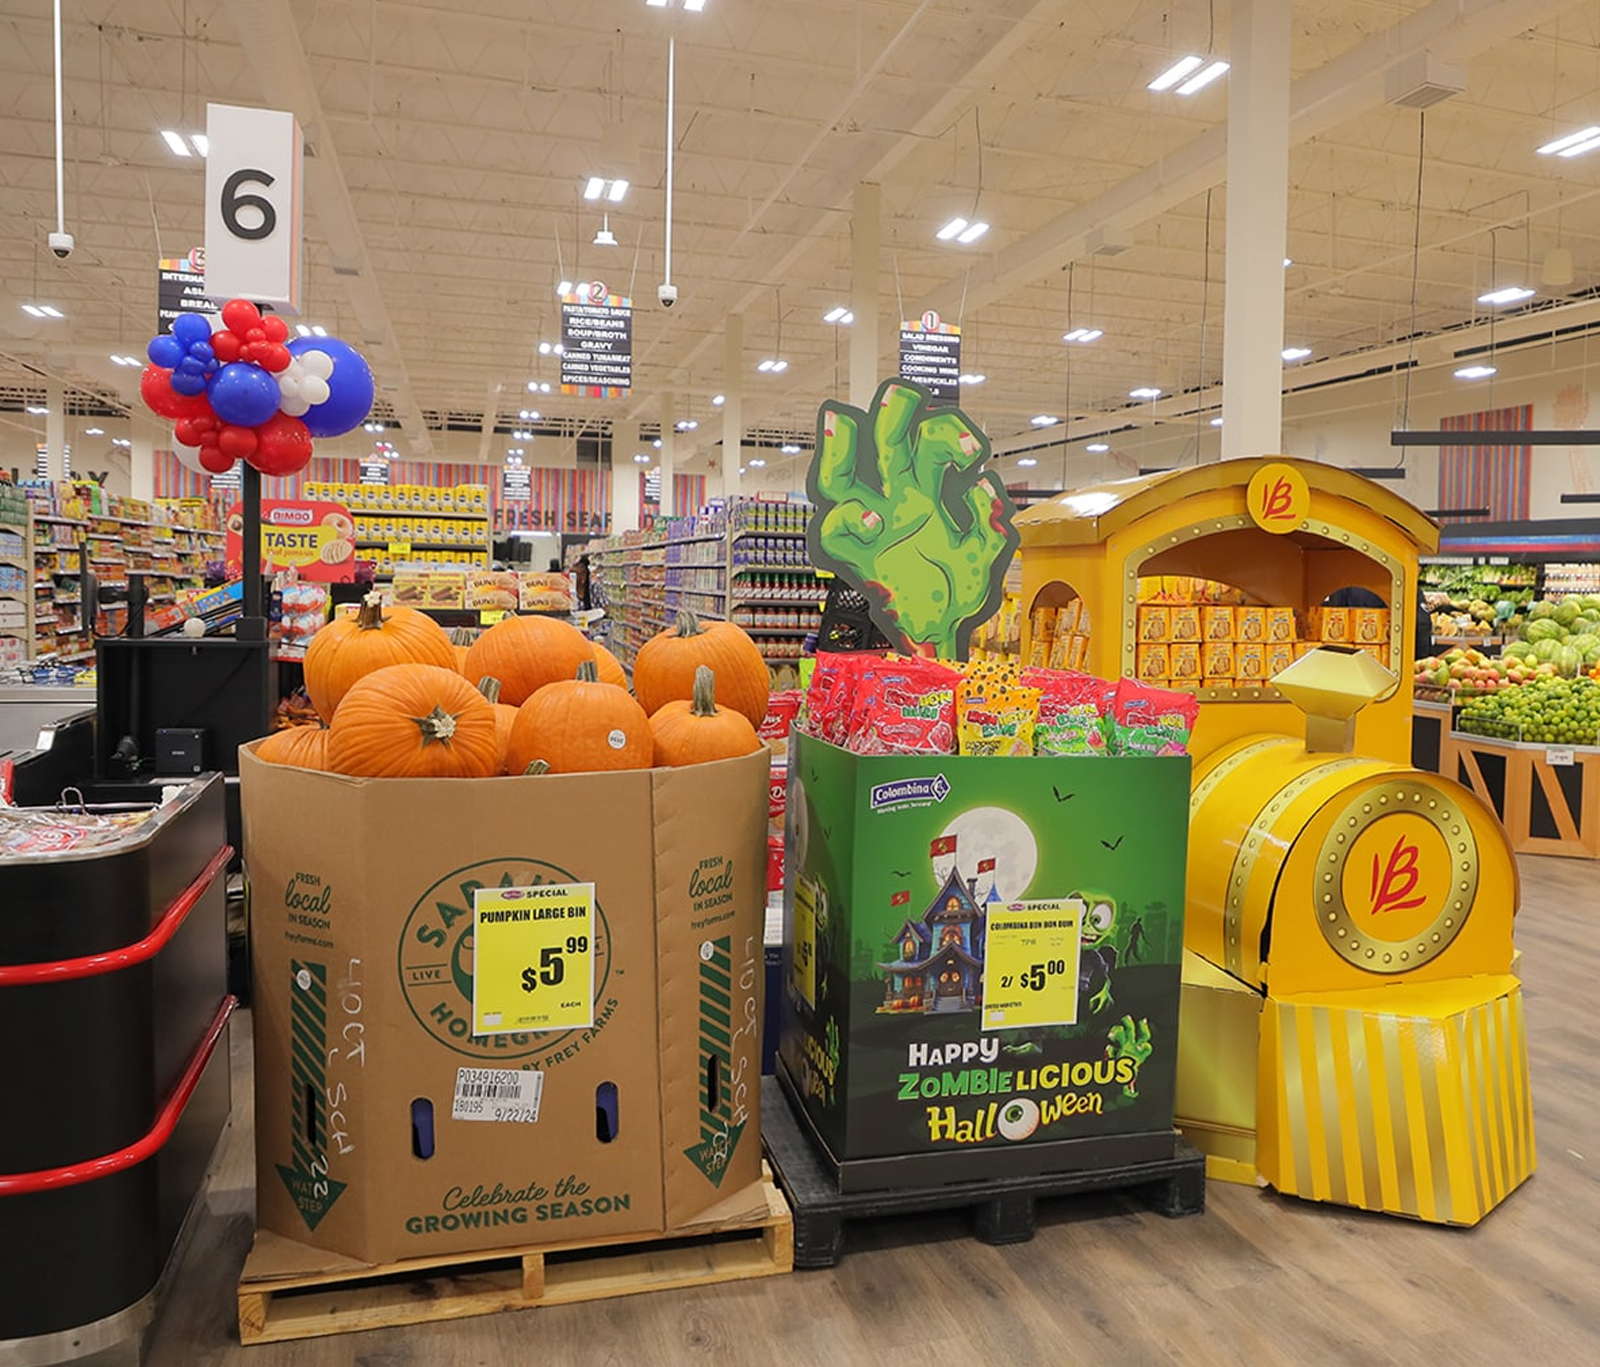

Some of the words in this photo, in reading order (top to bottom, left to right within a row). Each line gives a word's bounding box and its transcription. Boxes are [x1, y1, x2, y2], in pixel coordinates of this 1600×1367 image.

[221, 168, 276, 240] 6
[593, 283, 603, 300] 2
[569, 317, 625, 328] RICE/BEANS
[928, 312, 934, 328] 1
[567, 328, 627, 339] SOUP/BROTH
[580, 340, 613, 350] GRAVY
[493, 508, 555, 527] FRESH
[265, 532, 318, 549] TASTE
[919, 690, 953, 707] BON
[876, 782, 930, 801] Colombina
[699, 856, 724, 870] FRESH
[296, 872, 321, 886] FRESH
[689, 860, 733, 899] local
[285, 878, 331, 915] local
[527, 889, 568, 898] SPECIAL
[693, 902, 704, 912] IN
[704, 892, 733, 909] SEASON
[480, 910, 530, 923] PUMPKIN
[533, 907, 565, 920] LARGE
[568, 906, 586, 918] BIN
[1028, 903, 1061, 911] SPECIAL
[288, 912, 298, 923] IN
[299, 914, 331, 929] SEASON
[413, 970, 442, 981] LIVE
[1001, 975, 1014, 988] 2/
[522, 1060, 541, 1071] BY
[546, 1042, 582, 1068] FREY
[583, 997, 619, 1044] FARMS
[909, 1037, 999, 1067] HAPPY
[459, 1069, 519, 1084] P034916200
[495, 1108, 537, 1122] 9/22/24
[443, 1181, 549, 1211] Celebrate
[554, 1174, 591, 1198] the
[405, 1207, 528, 1235] GROWING
[535, 1193, 631, 1221] SEASON
